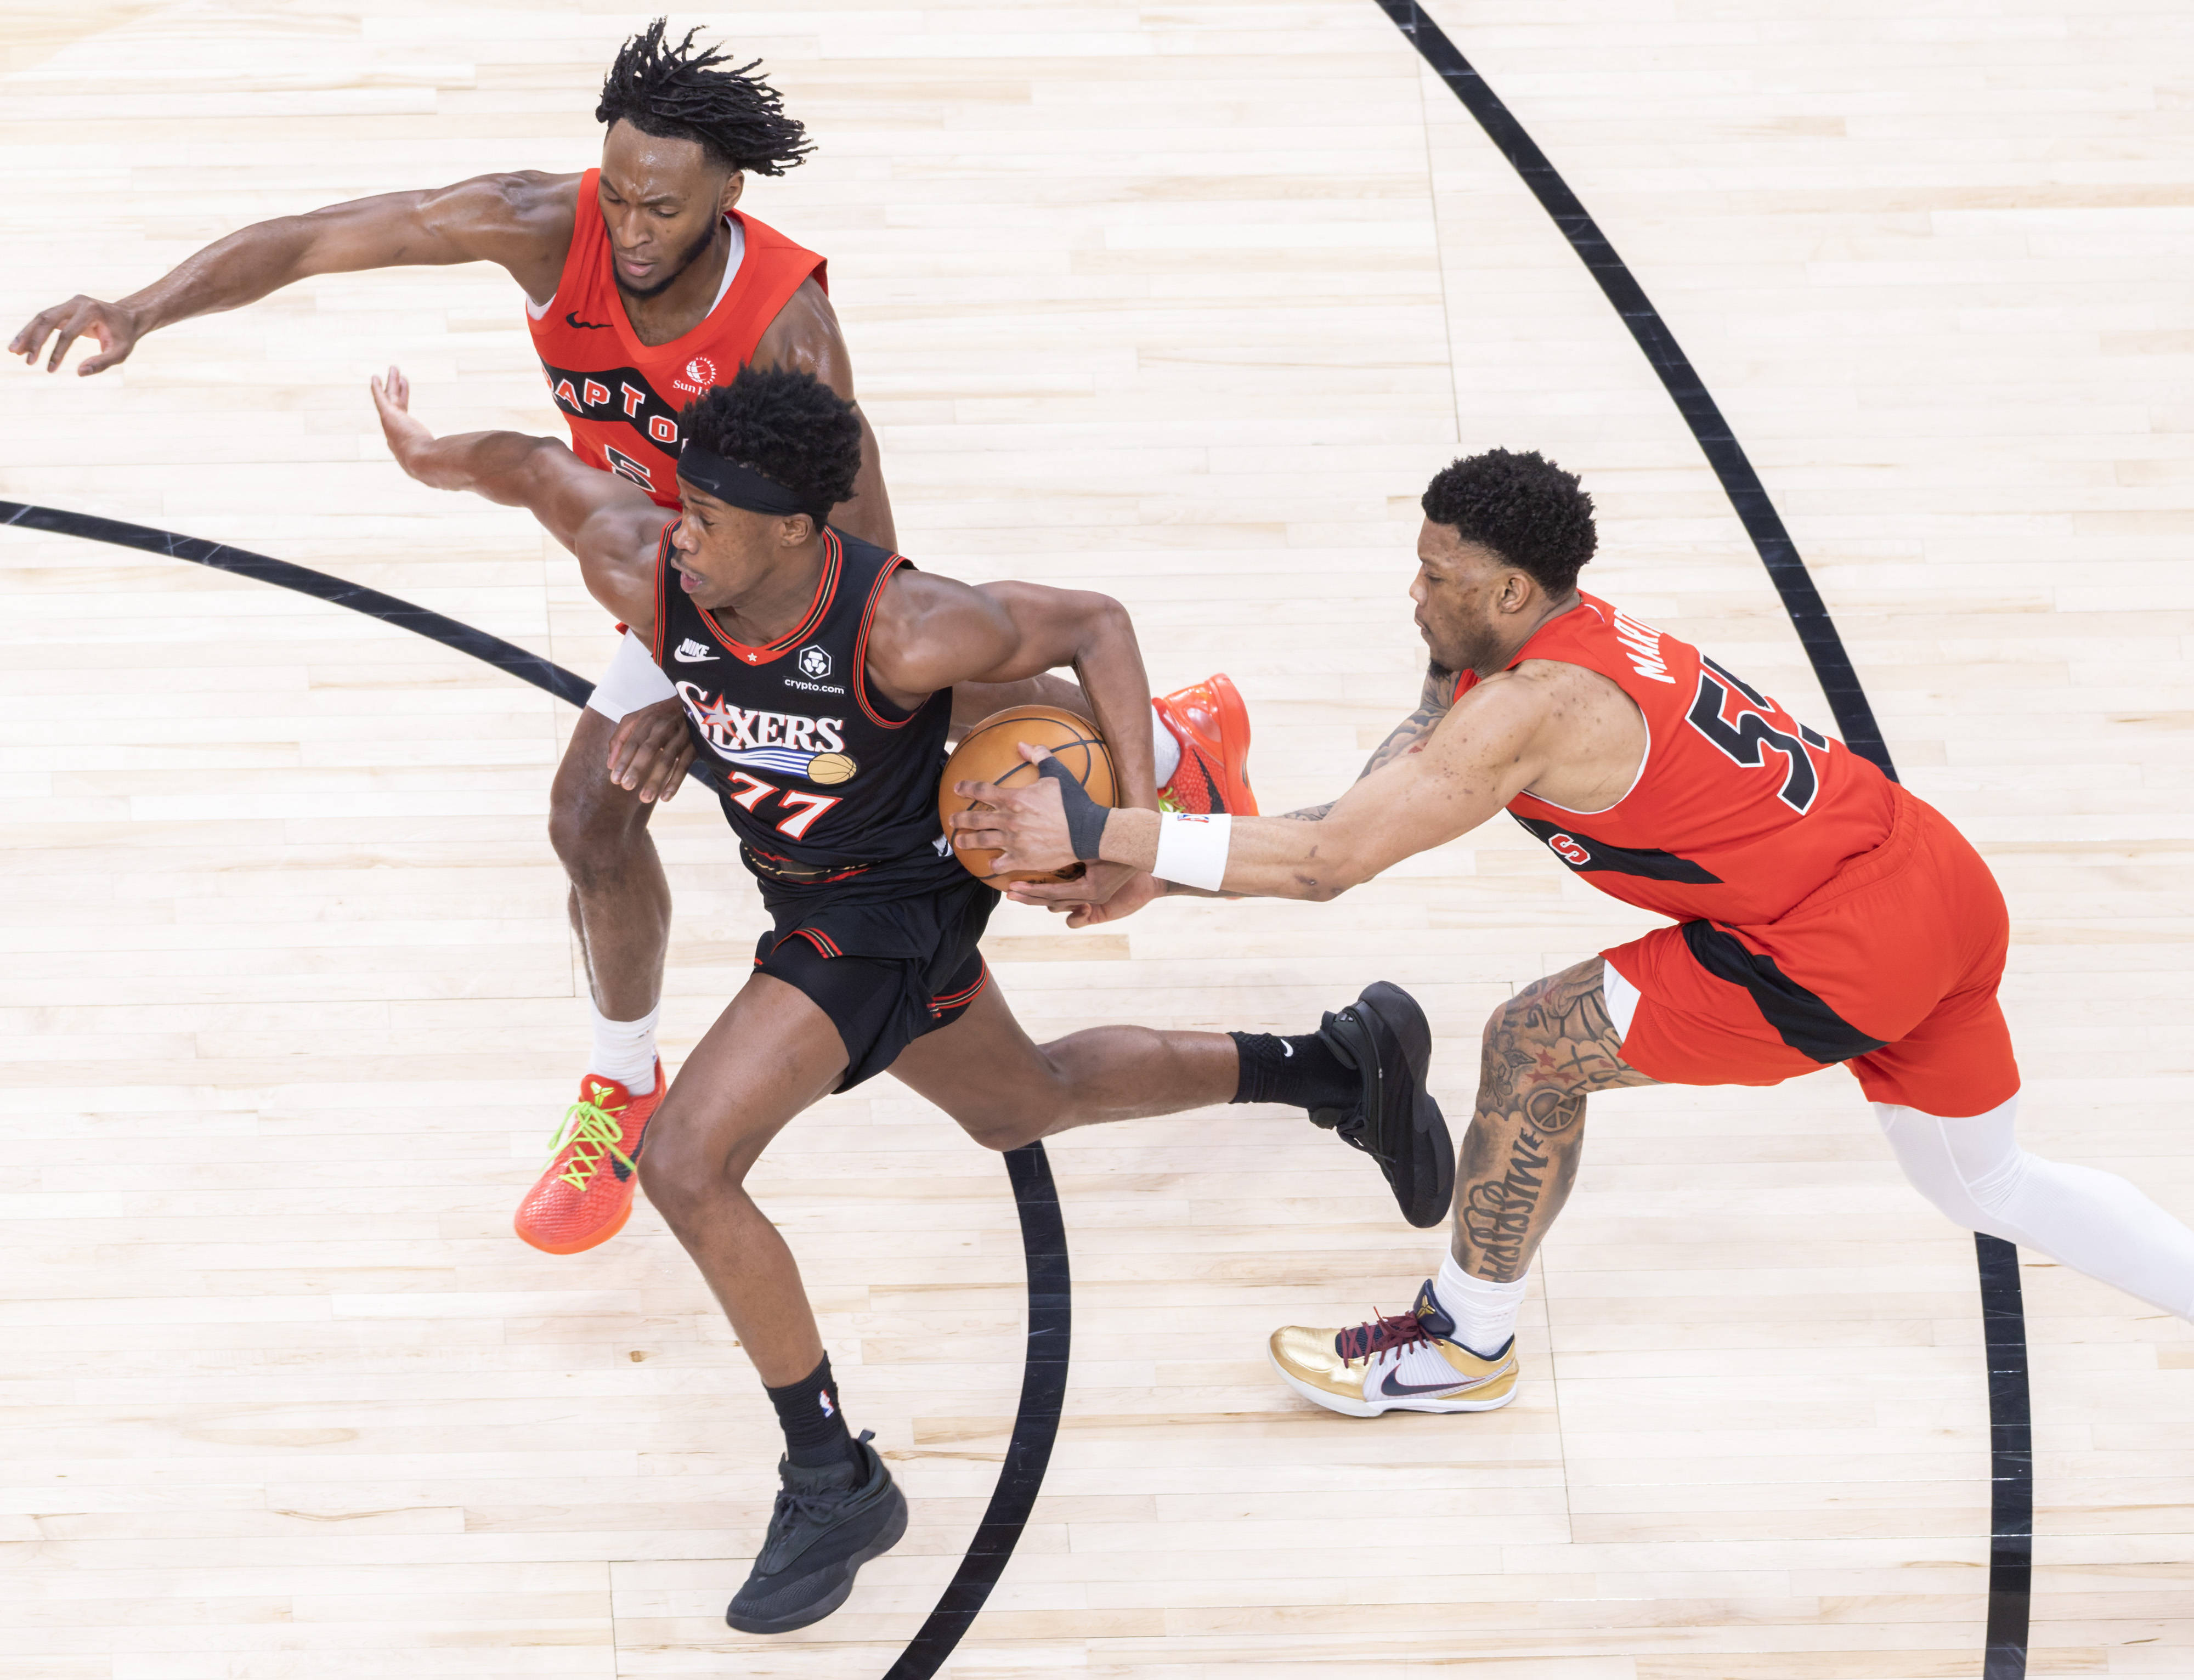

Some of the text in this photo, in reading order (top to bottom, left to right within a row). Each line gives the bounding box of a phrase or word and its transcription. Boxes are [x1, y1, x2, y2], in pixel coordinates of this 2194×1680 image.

[541, 365, 689, 453] APTO
[672, 380, 695, 393] Sun
[681, 638, 710, 658] NIKE
[1613, 609, 1676, 684] MARTI
[784, 679, 844, 694] crypto.com
[728, 771, 844, 842] 77
